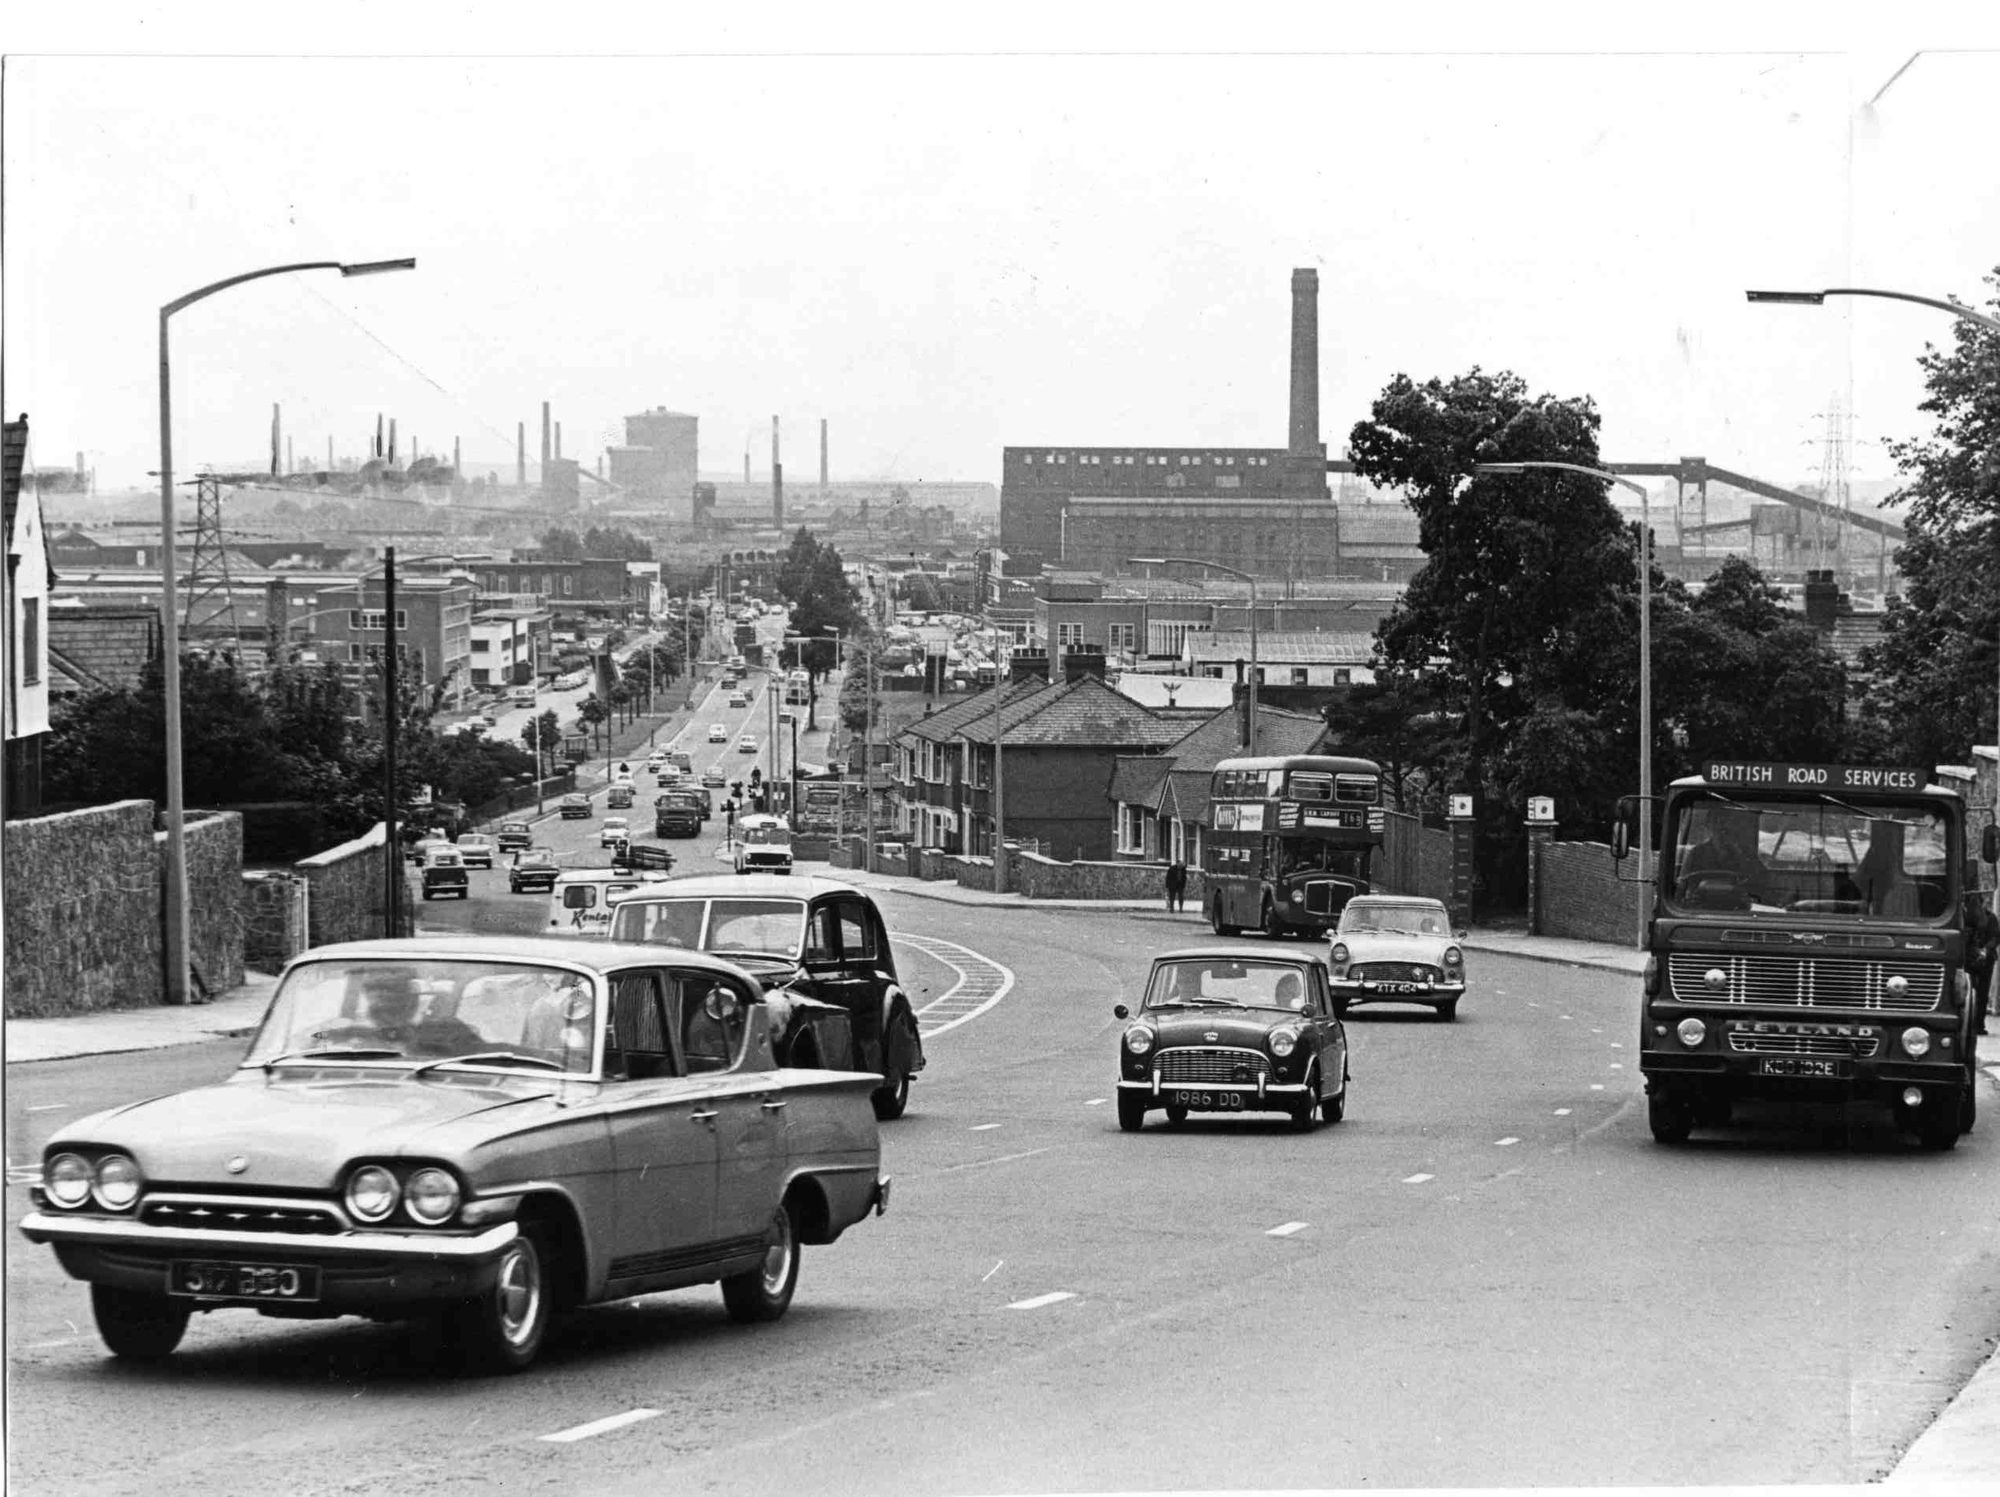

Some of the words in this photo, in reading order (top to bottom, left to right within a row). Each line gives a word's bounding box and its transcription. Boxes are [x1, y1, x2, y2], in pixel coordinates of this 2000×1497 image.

[1710, 764, 1773, 783] BRITISH
[1788, 768, 1828, 784] ROAD
[1844, 769, 1917, 788] SERVICES
[1734, 1021, 1873, 1037] LEYLAND
[1174, 1090, 1211, 1106] 1986
[1219, 1092, 1241, 1107] DD
